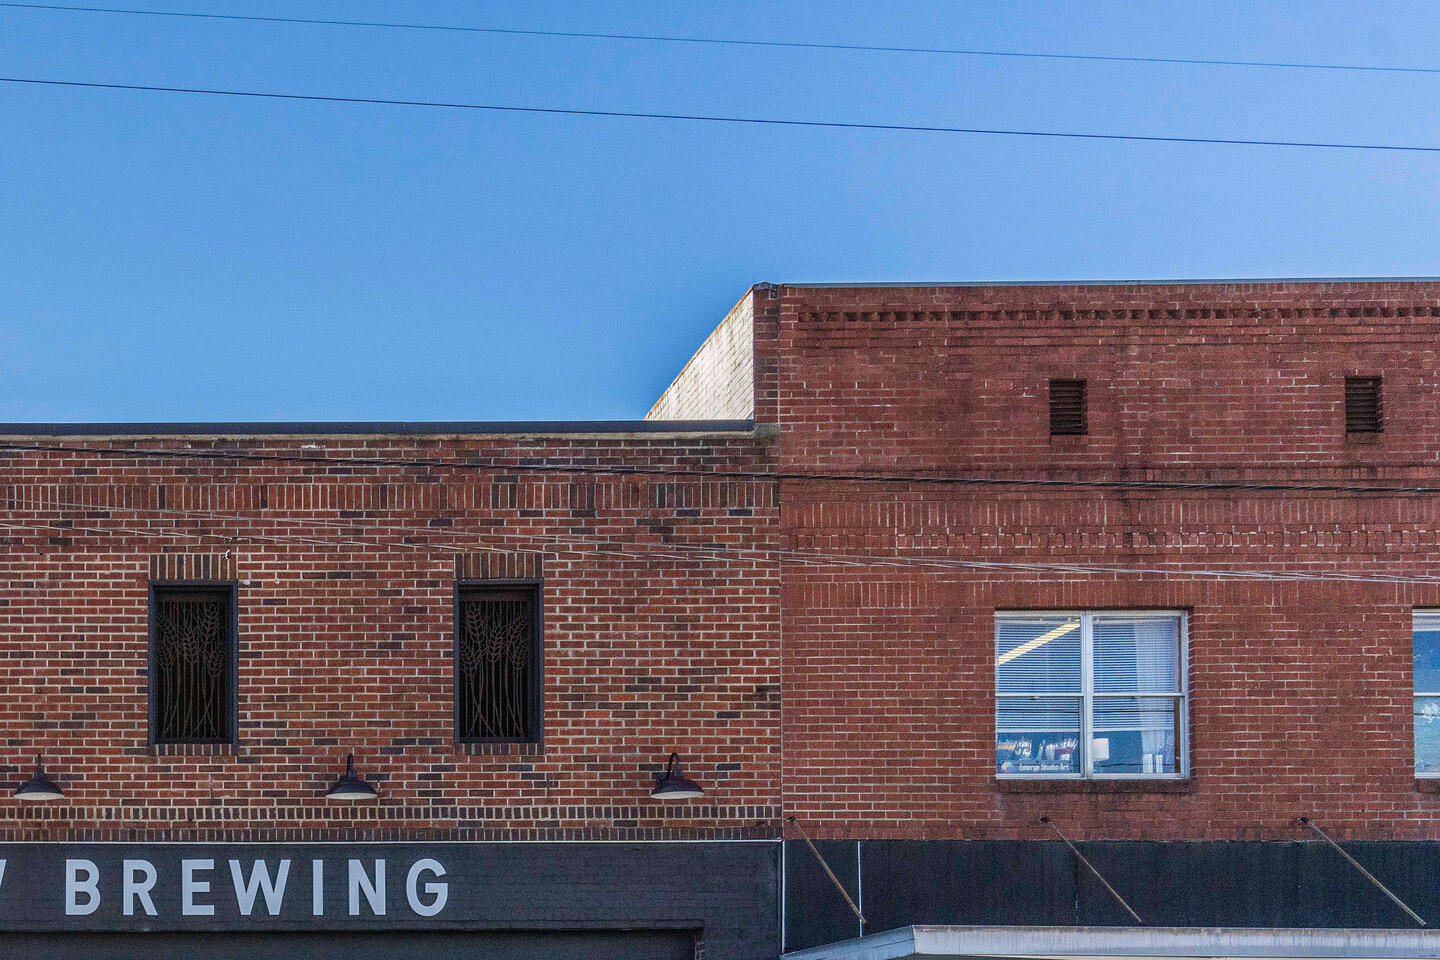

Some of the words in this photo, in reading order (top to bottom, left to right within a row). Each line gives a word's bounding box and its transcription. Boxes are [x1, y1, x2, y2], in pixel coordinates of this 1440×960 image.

[1019, 763, 1040, 772] Emerge
[1041, 763, 1059, 771] Studio
[1060, 763, 1069, 771] Art
[65, 858, 449, 917] BREWING
